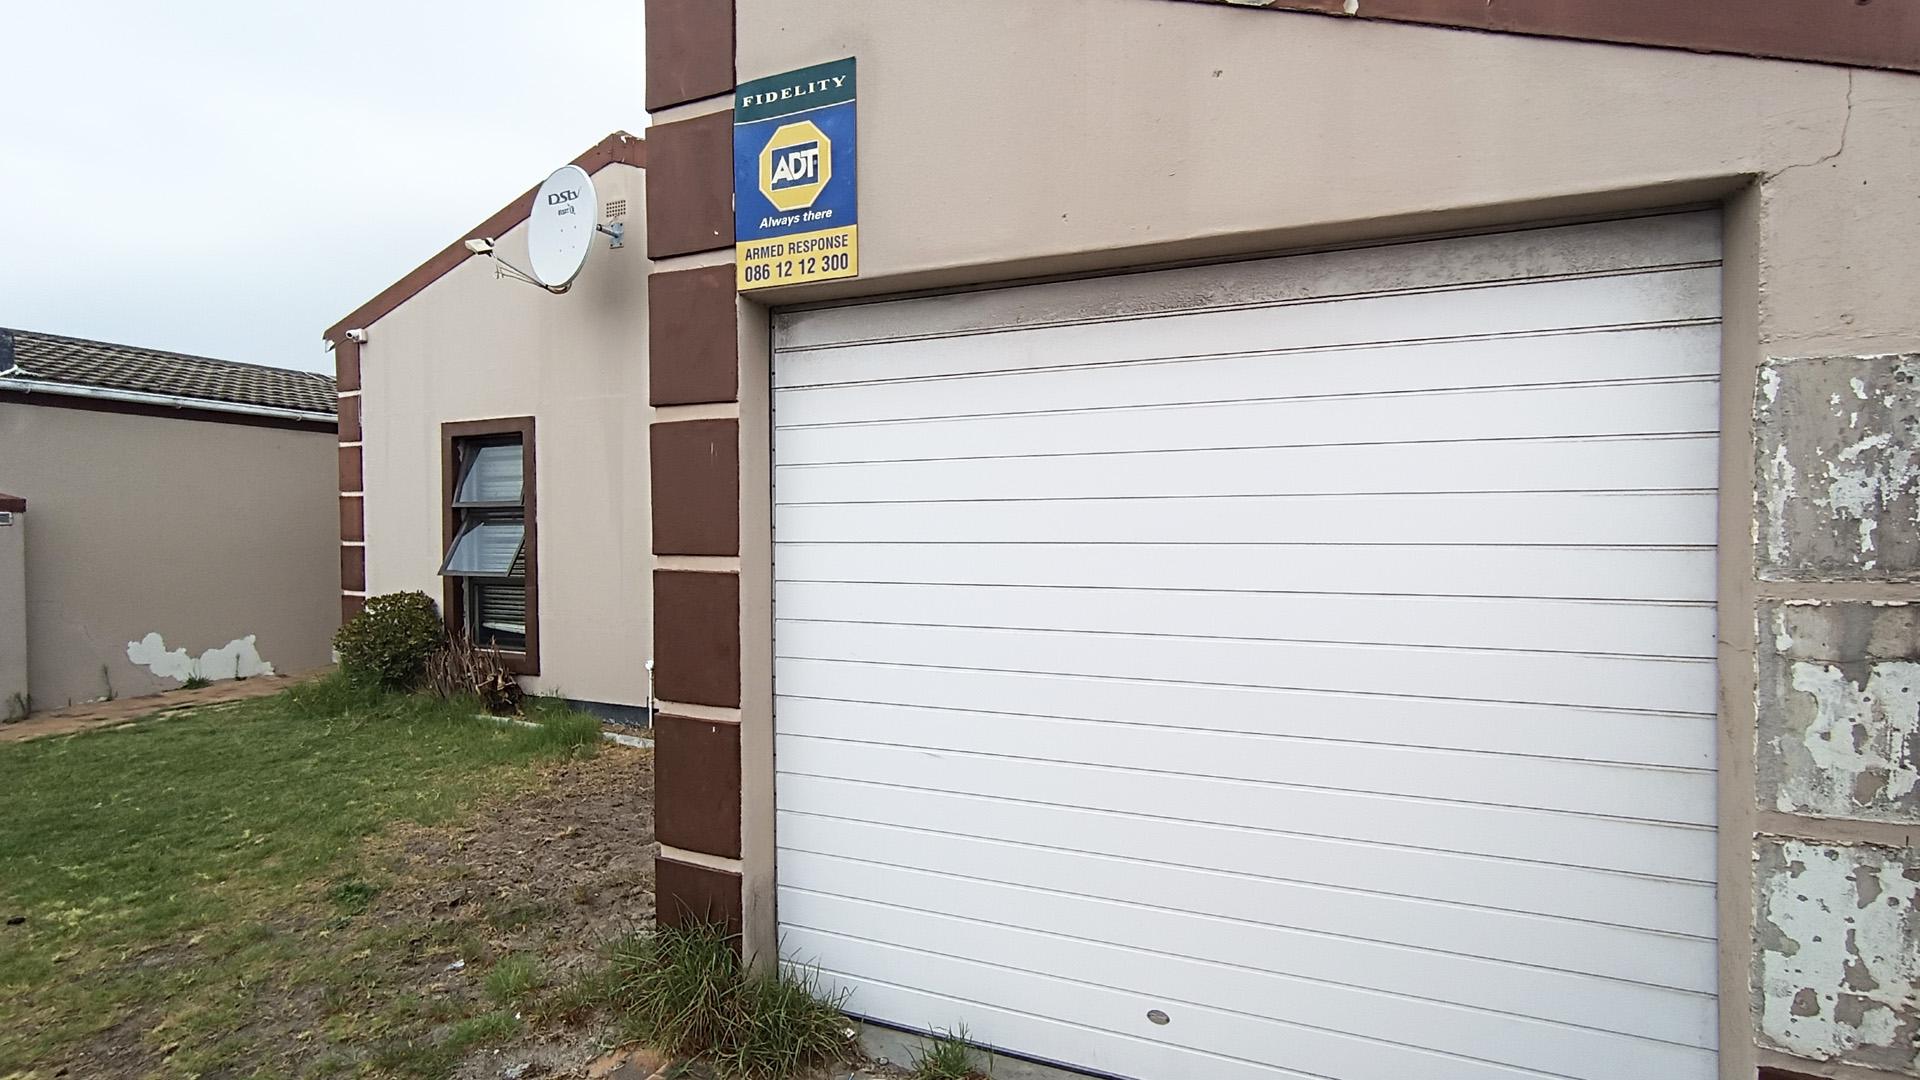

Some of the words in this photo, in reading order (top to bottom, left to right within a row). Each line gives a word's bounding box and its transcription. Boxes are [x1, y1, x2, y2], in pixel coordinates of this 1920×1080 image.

[742, 75, 846, 108] FIDELITY
[772, 150, 819, 184] ADT
[759, 213, 800, 229] Always
[803, 209, 833, 222] there
[745, 244, 784, 261] ARMED
[788, 234, 849, 254] RESPONSE
[745, 264, 770, 283] 086
[776, 260, 793, 278] 12
[798, 257, 816, 275] 12
[821, 252, 849, 272] 300
